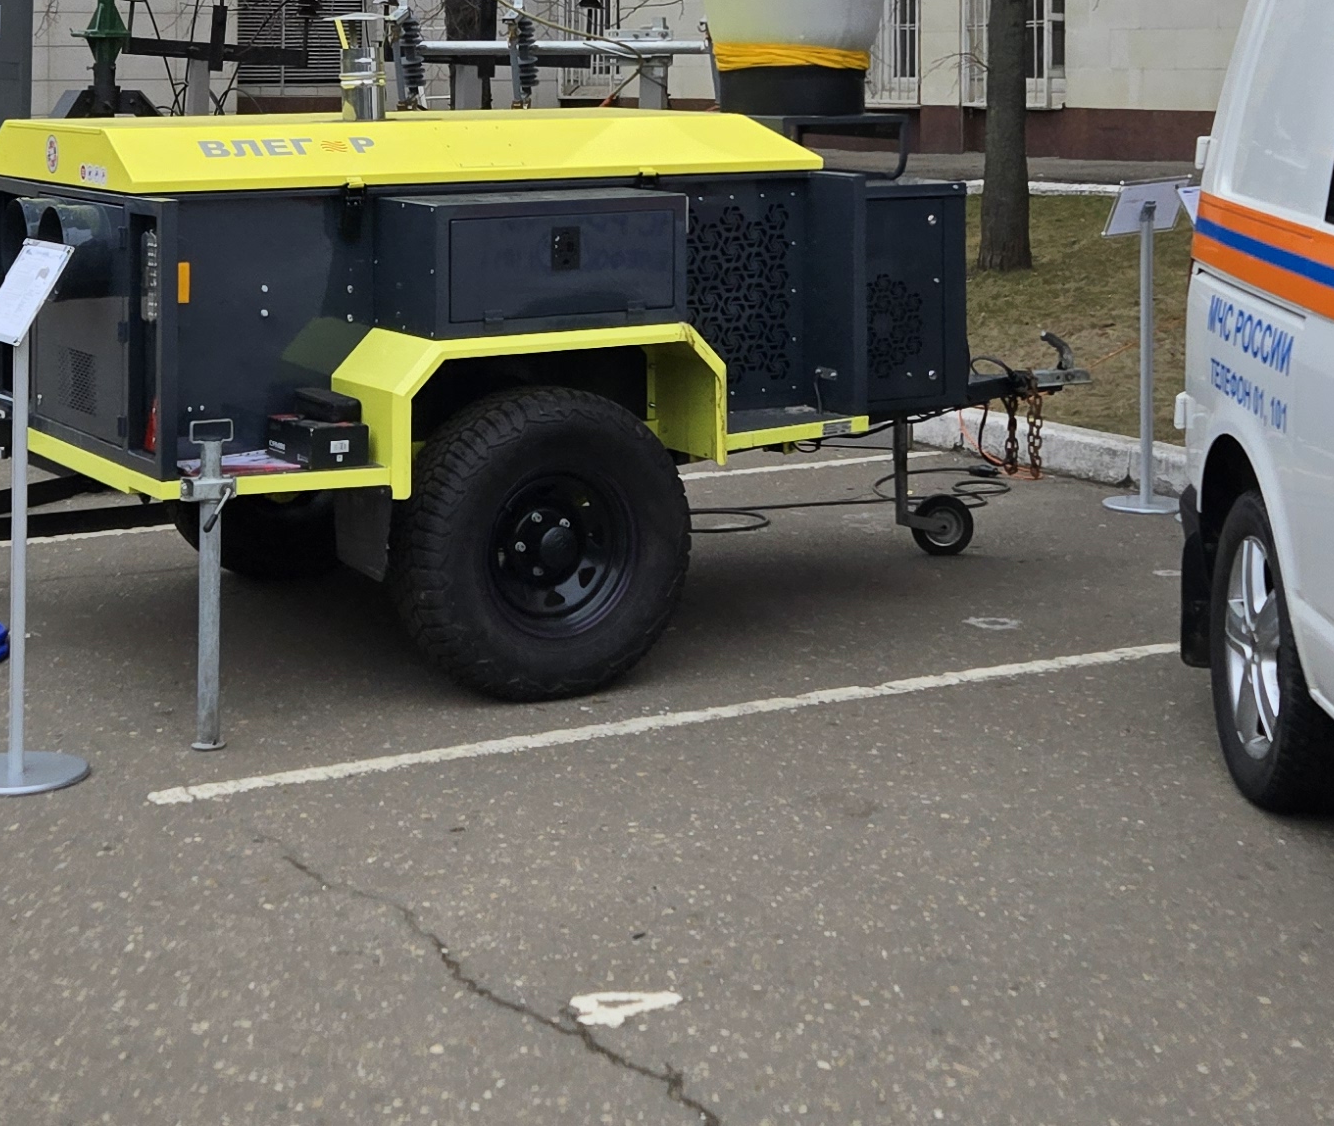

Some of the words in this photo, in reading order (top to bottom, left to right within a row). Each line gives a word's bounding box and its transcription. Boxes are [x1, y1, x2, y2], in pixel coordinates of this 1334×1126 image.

[197, 136, 375, 158] ВЛЕГР
[1207, 294, 1234, 342] МЧС
[1232, 309, 1295, 377] РОССИИ
[1210, 357, 1252, 411] ТЕЛЕФОН
[1270, 396, 1287, 434] 101
